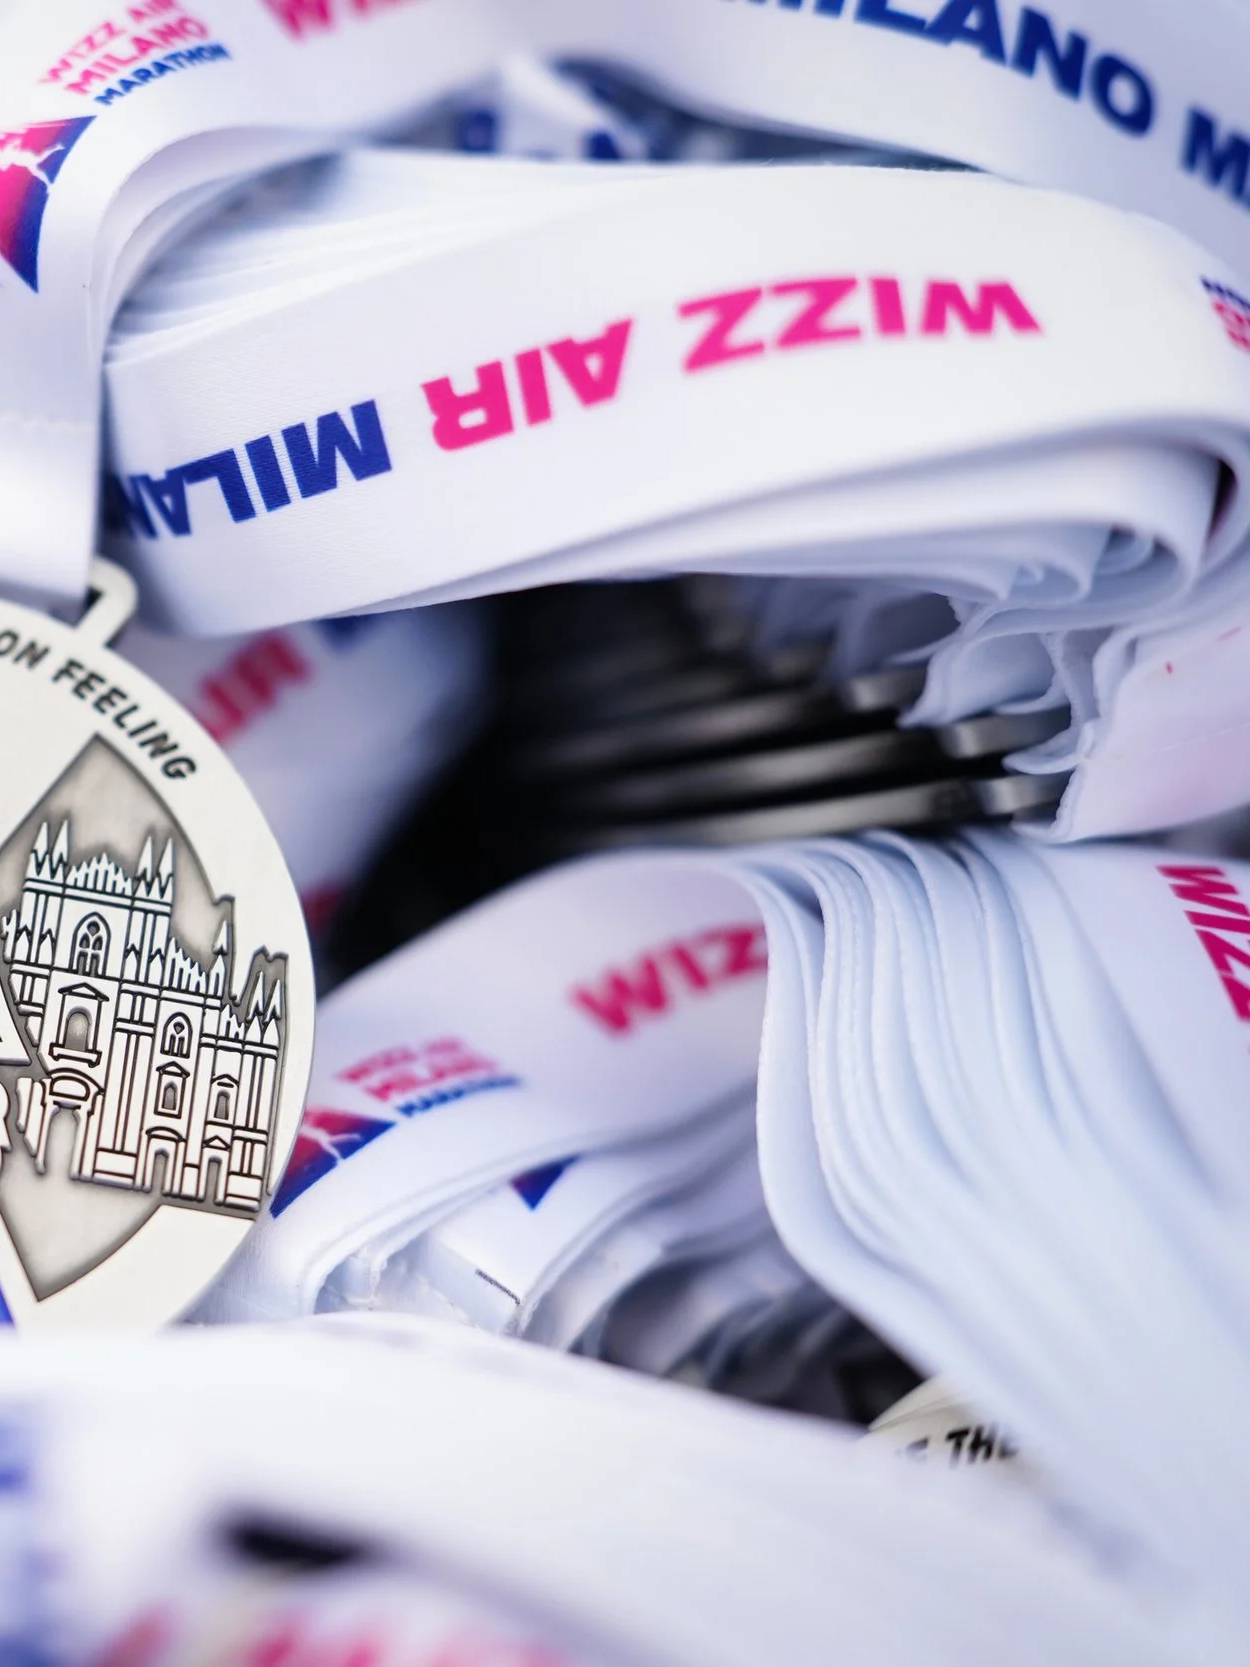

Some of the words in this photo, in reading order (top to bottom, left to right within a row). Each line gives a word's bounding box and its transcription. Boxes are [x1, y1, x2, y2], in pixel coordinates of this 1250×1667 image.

[63, 16, 209, 95] MILANO
[93, 42, 233, 106] MARATHON
[725, 0, 1154, 138] LANO
[676, 276, 1044, 375] WIZZ
[421, 317, 634, 453] AIR
[51, 657, 198, 780] FEELING
